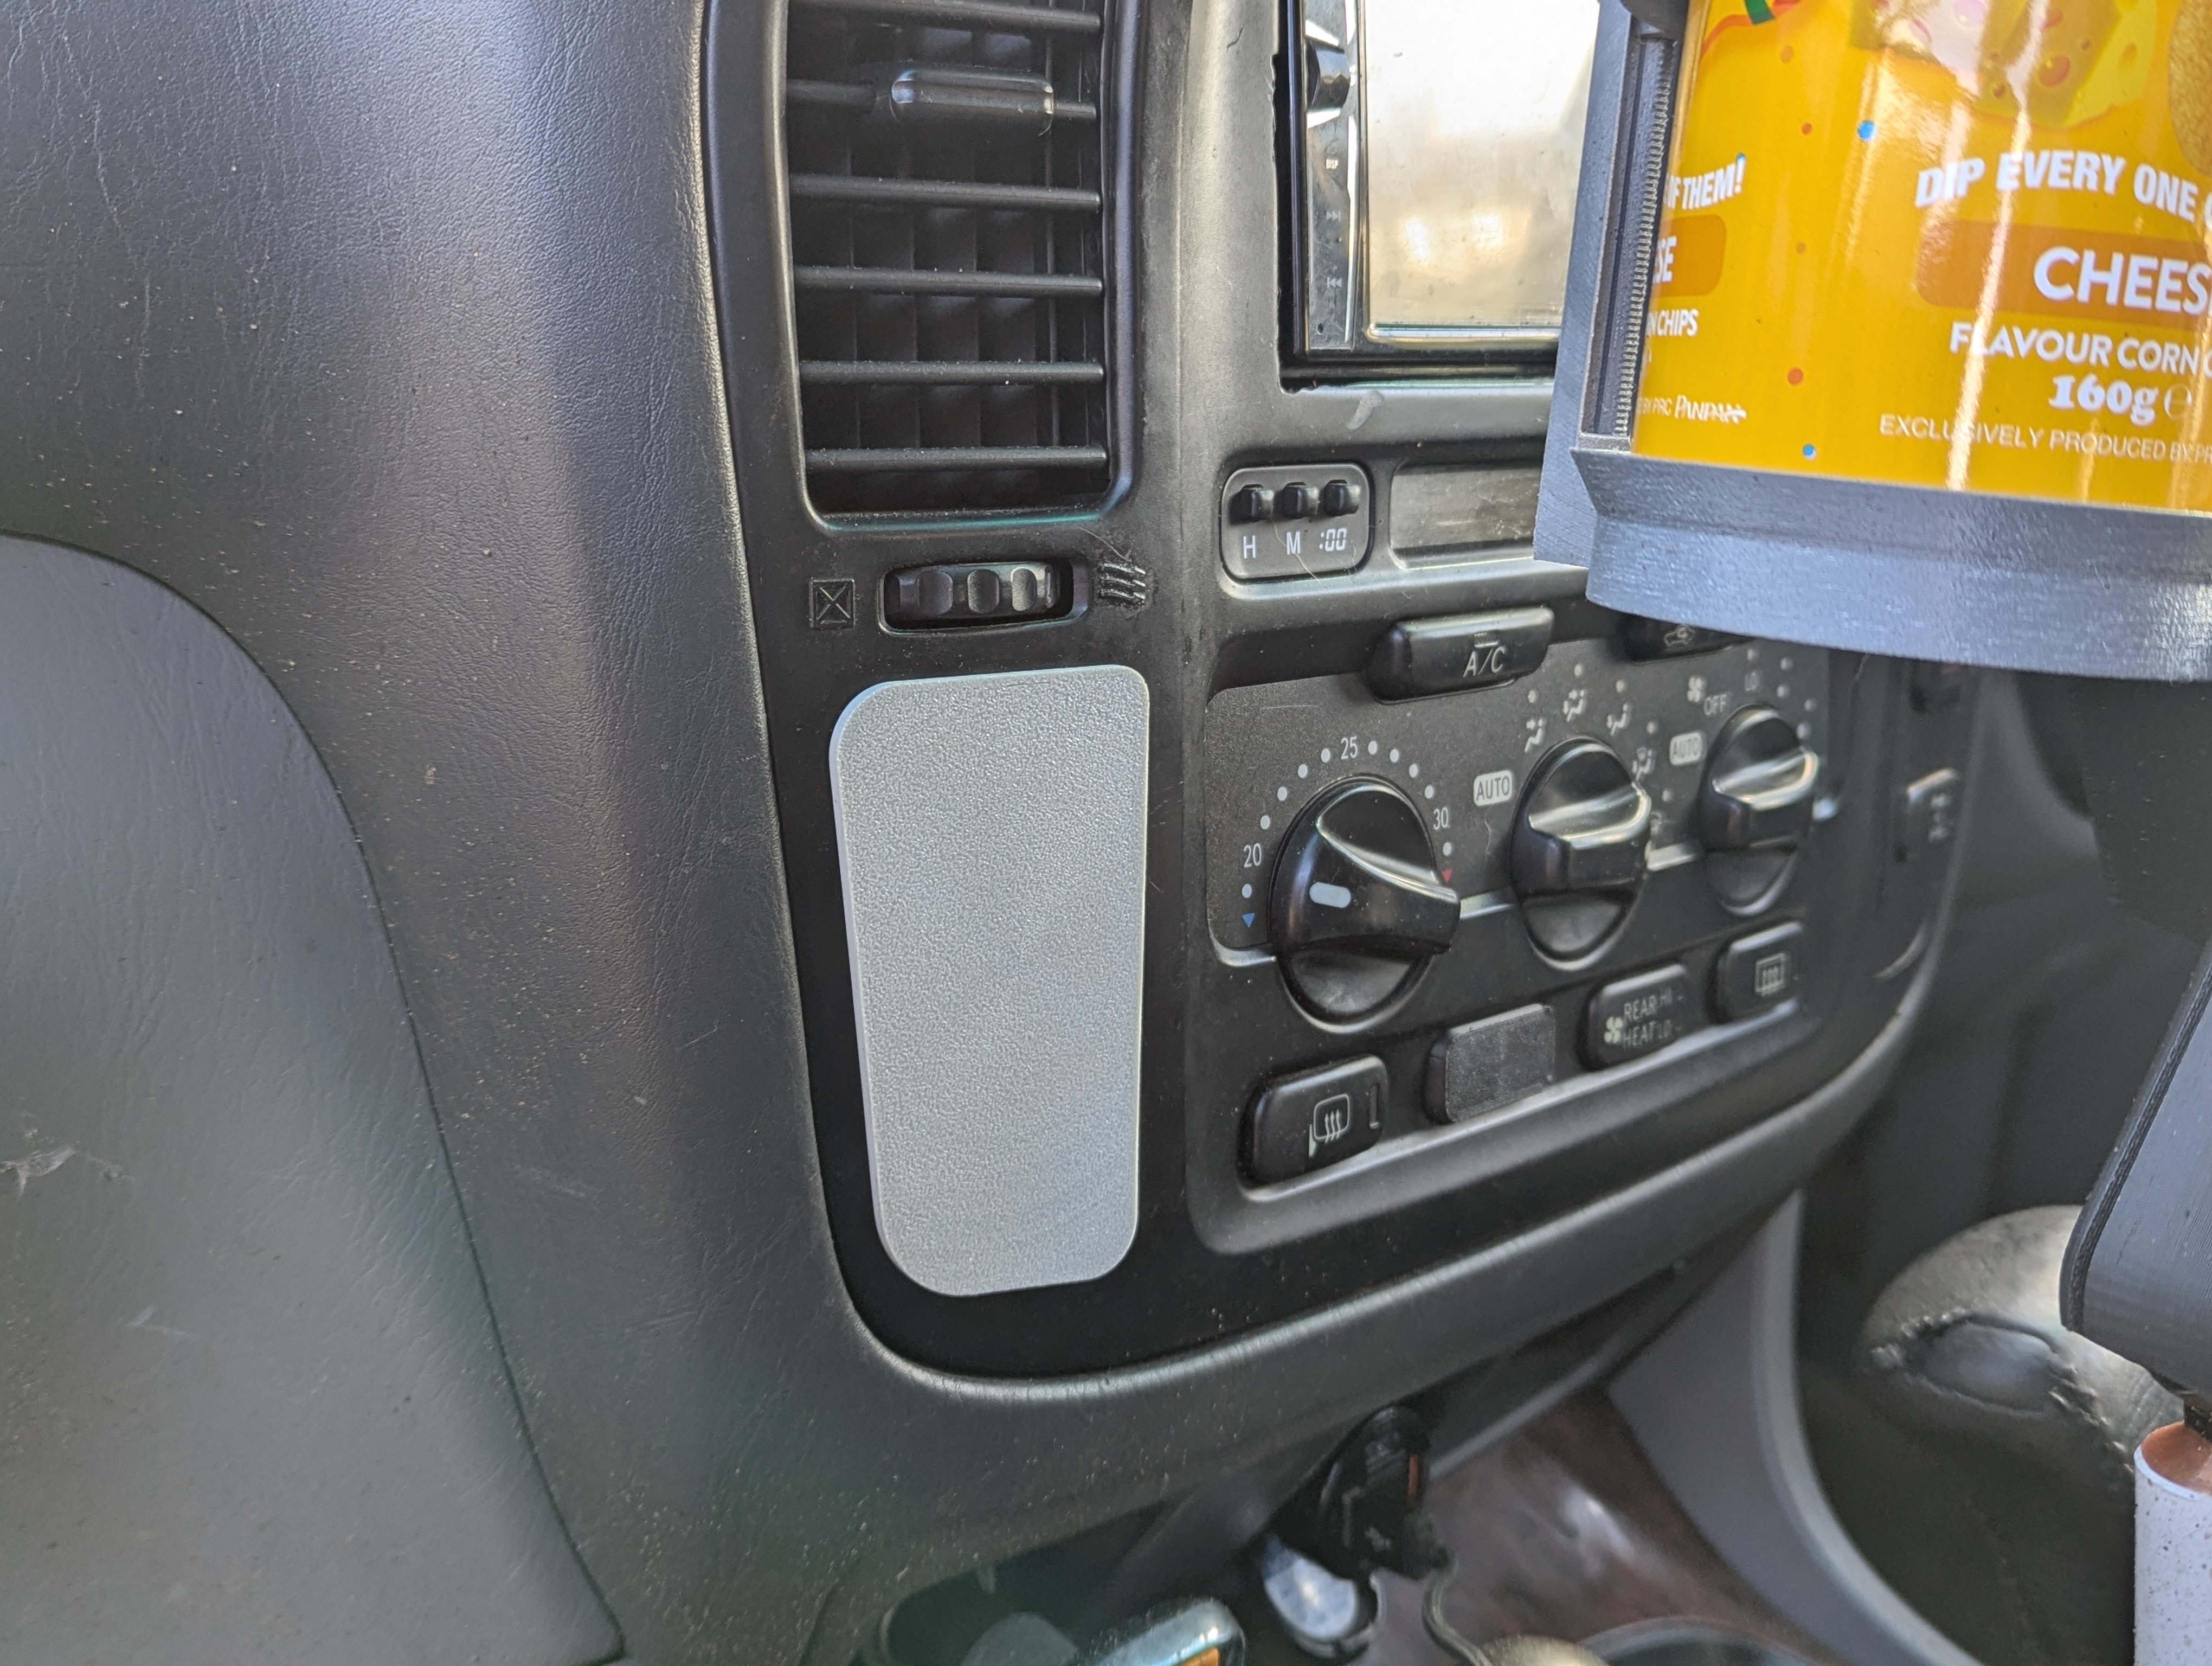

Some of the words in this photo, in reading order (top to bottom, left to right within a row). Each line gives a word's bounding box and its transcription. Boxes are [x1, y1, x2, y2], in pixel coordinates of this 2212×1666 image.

[1682, 157, 1746, 210] THEM!
[1915, 158, 1985, 208] DIP
[1996, 149, 2126, 195] EVERY
[2133, 164, 2198, 222] ONE
[2033, 246, 2212, 316] CHEES
[1657, 309, 1699, 336] CHIPS
[1950, 321, 2112, 368] FLAVOUR
[2117, 338, 2199, 375] CORN
[2048, 373, 2159, 426] 160g
[2049, 429, 2166, 461] PRODUCED
[1243, 535, 1256, 559] H
[1286, 531, 1301, 554] M
[1463, 645, 1506, 678] A/C
[1703, 694, 1726, 715] OFF
[1341, 736, 1358, 759] 25
[1672, 738, 1699, 759] AUTO
[1476, 776, 1510, 801] AUTO
[1433, 807, 1449, 829] 30
[1244, 843, 1262, 867] 20
[1624, 995, 1657, 1021] REAR
[1623, 1021, 1656, 1048] HEAT
